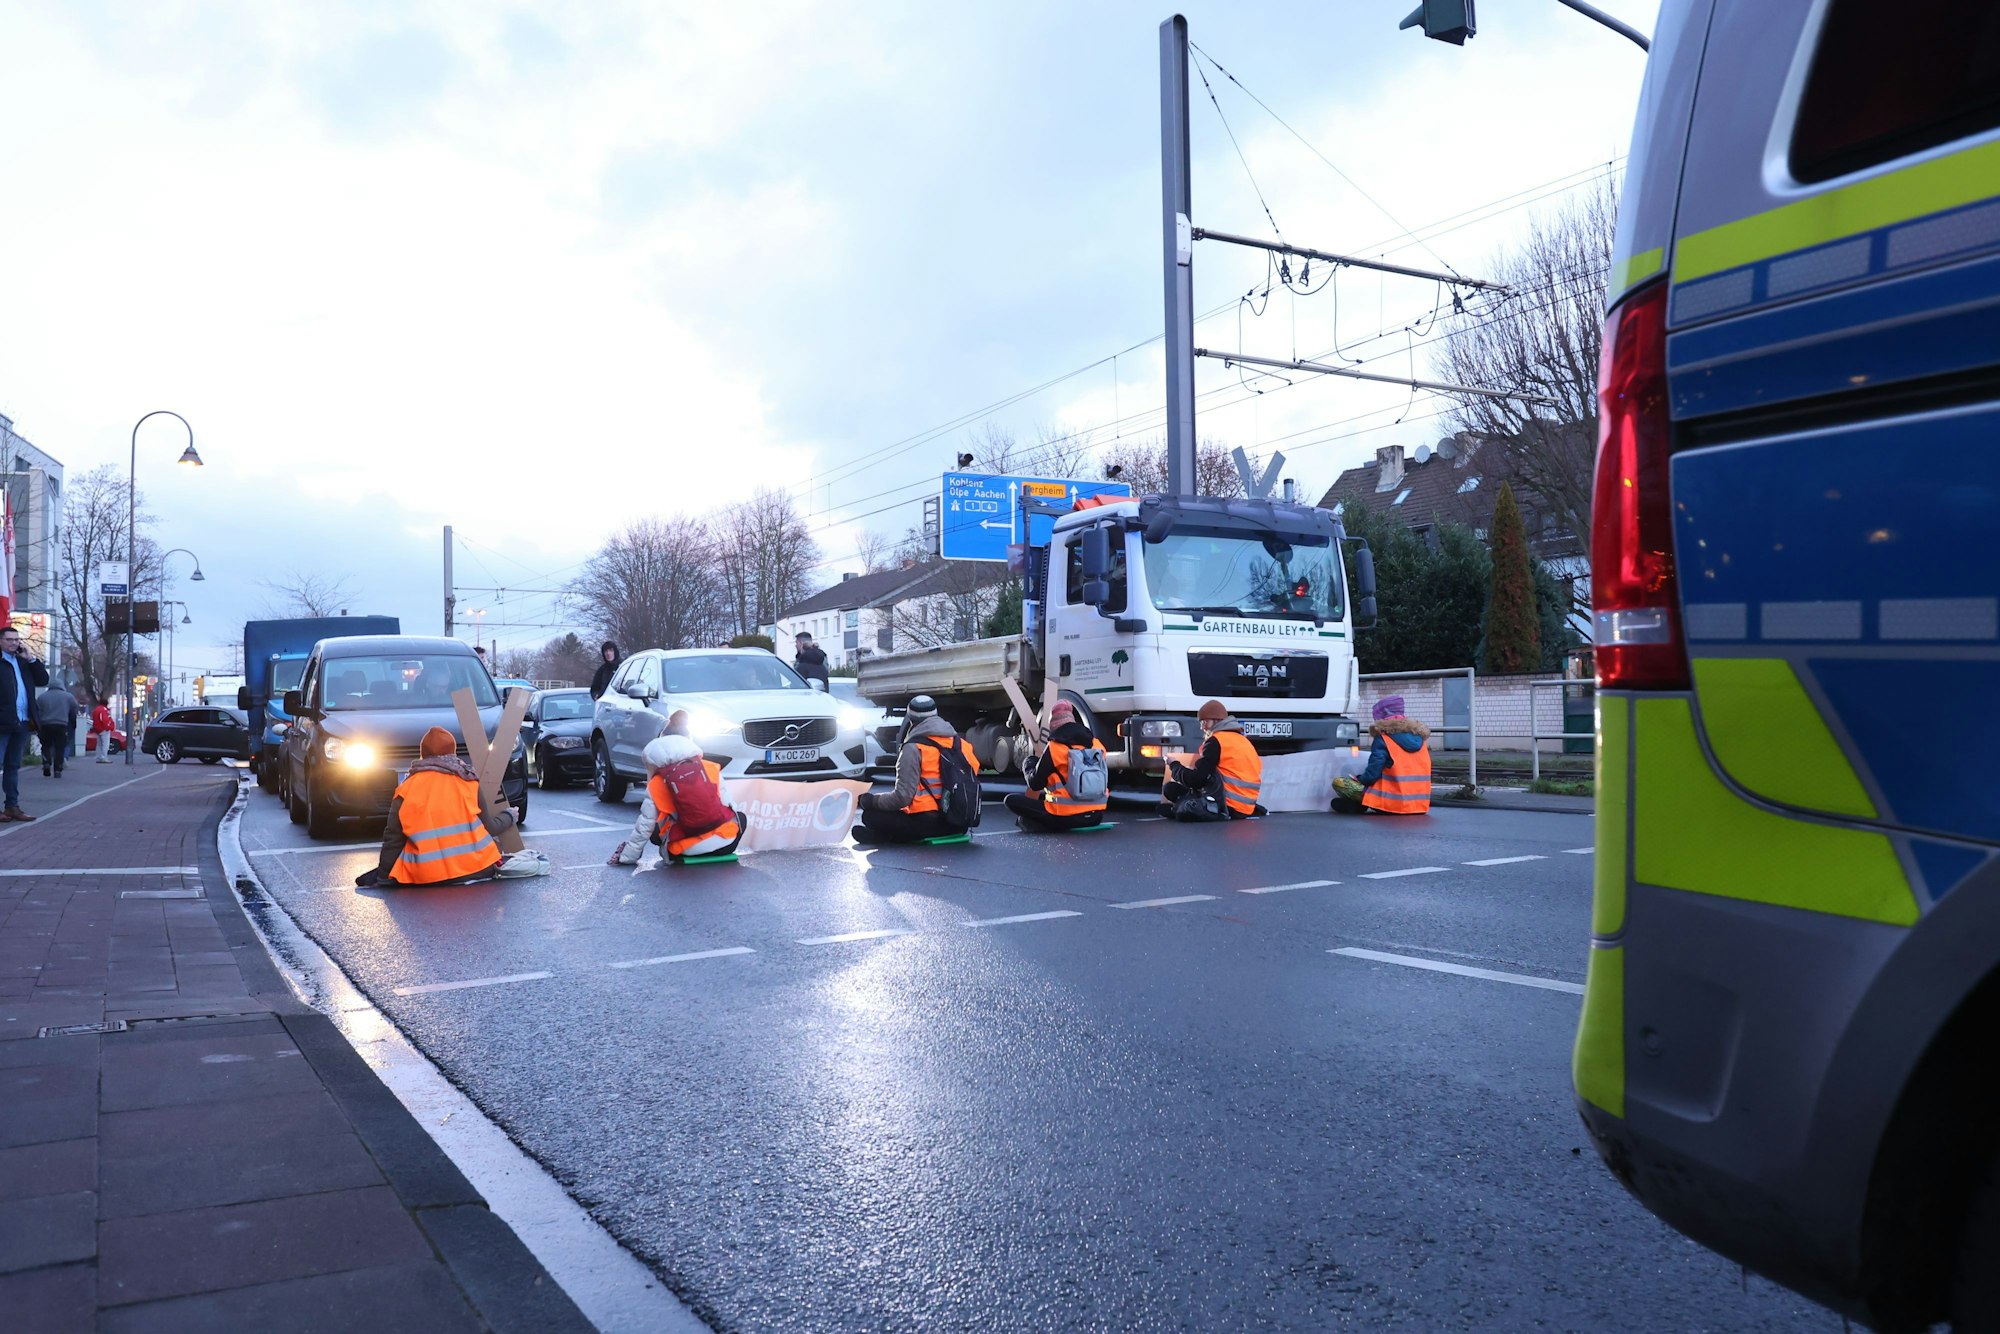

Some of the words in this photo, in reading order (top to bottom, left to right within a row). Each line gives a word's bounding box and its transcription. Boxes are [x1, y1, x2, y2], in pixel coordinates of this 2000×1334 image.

[949, 487, 969, 498] Olpe
[974, 489, 1006, 499] Aachen
[1203, 621, 1275, 635] GARTENBAU
[1279, 625, 1298, 636] LEY
[1237, 664, 1287, 677] MAN
[1245, 723, 1255, 734] BM
[775, 752, 781, 761] K
